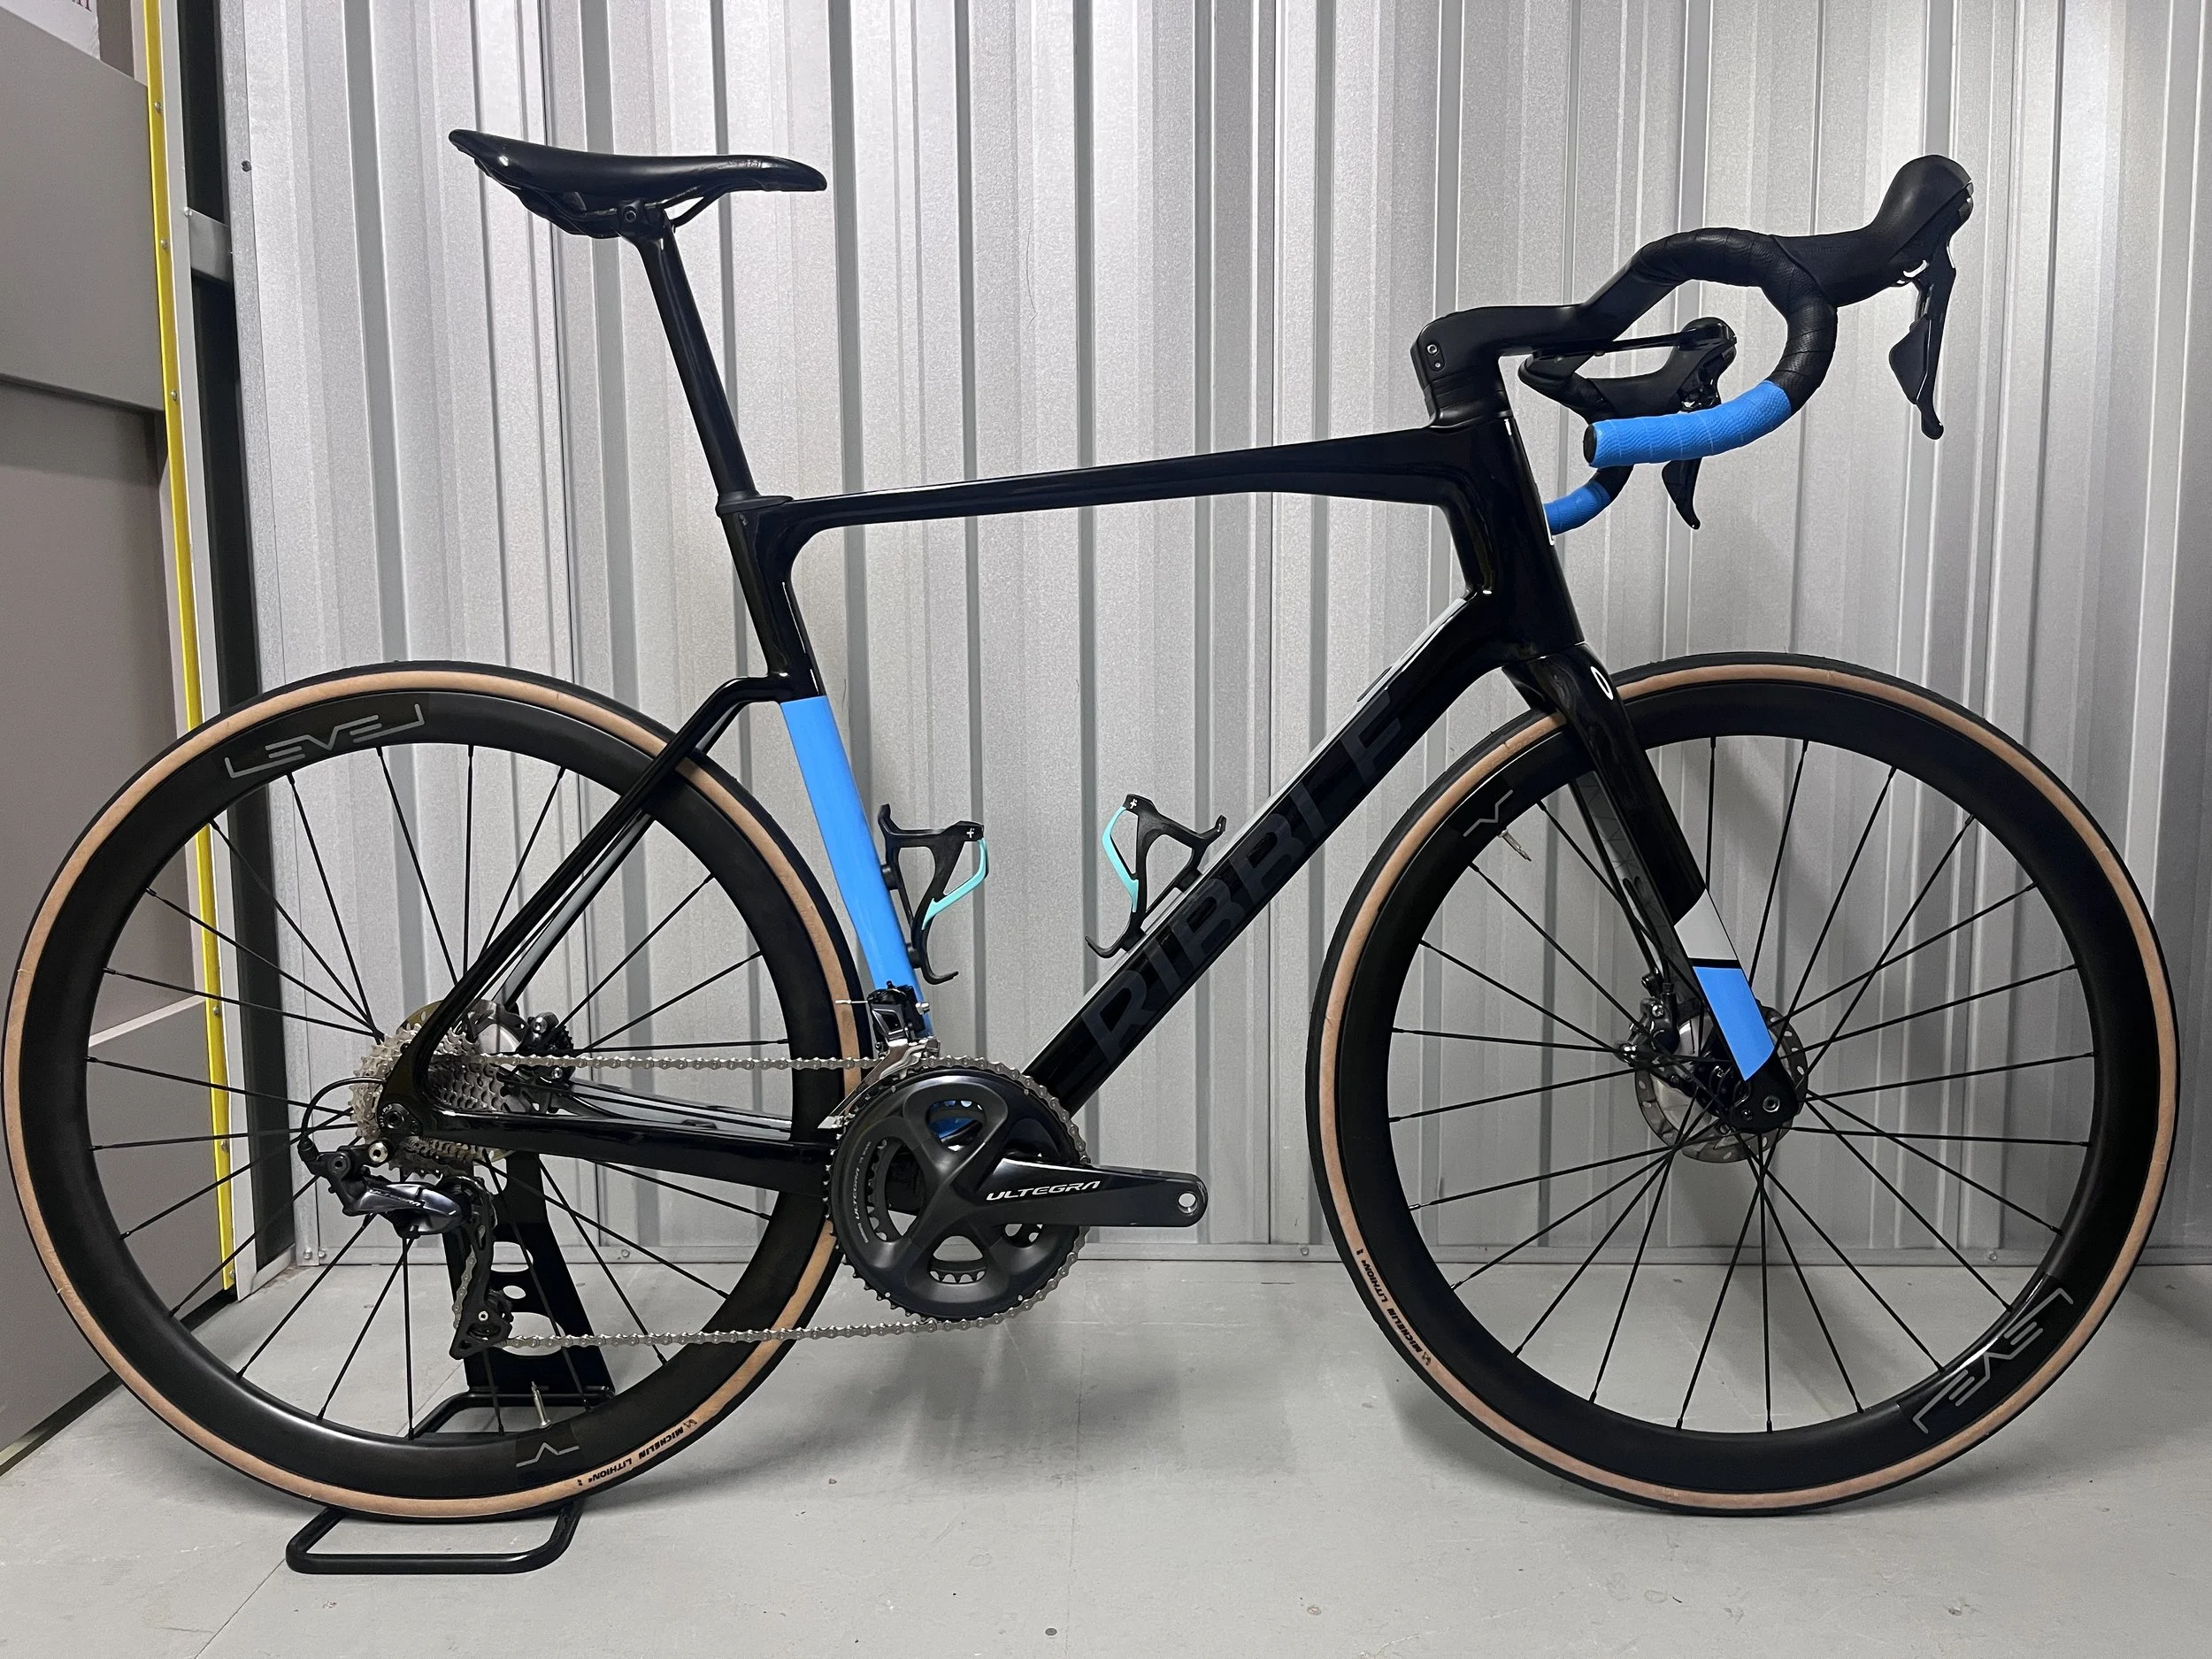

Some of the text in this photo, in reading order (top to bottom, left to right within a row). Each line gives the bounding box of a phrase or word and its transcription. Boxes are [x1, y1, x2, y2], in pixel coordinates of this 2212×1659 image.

[224, 703, 426, 779] LEVEL
[986, 1180, 1101, 1201] ULTEGRA
[1386, 1308, 1424, 1354] MICHELIN
[1912, 1287, 2074, 1434] LEVEL
[638, 1425, 684, 1460] MICHELIN
